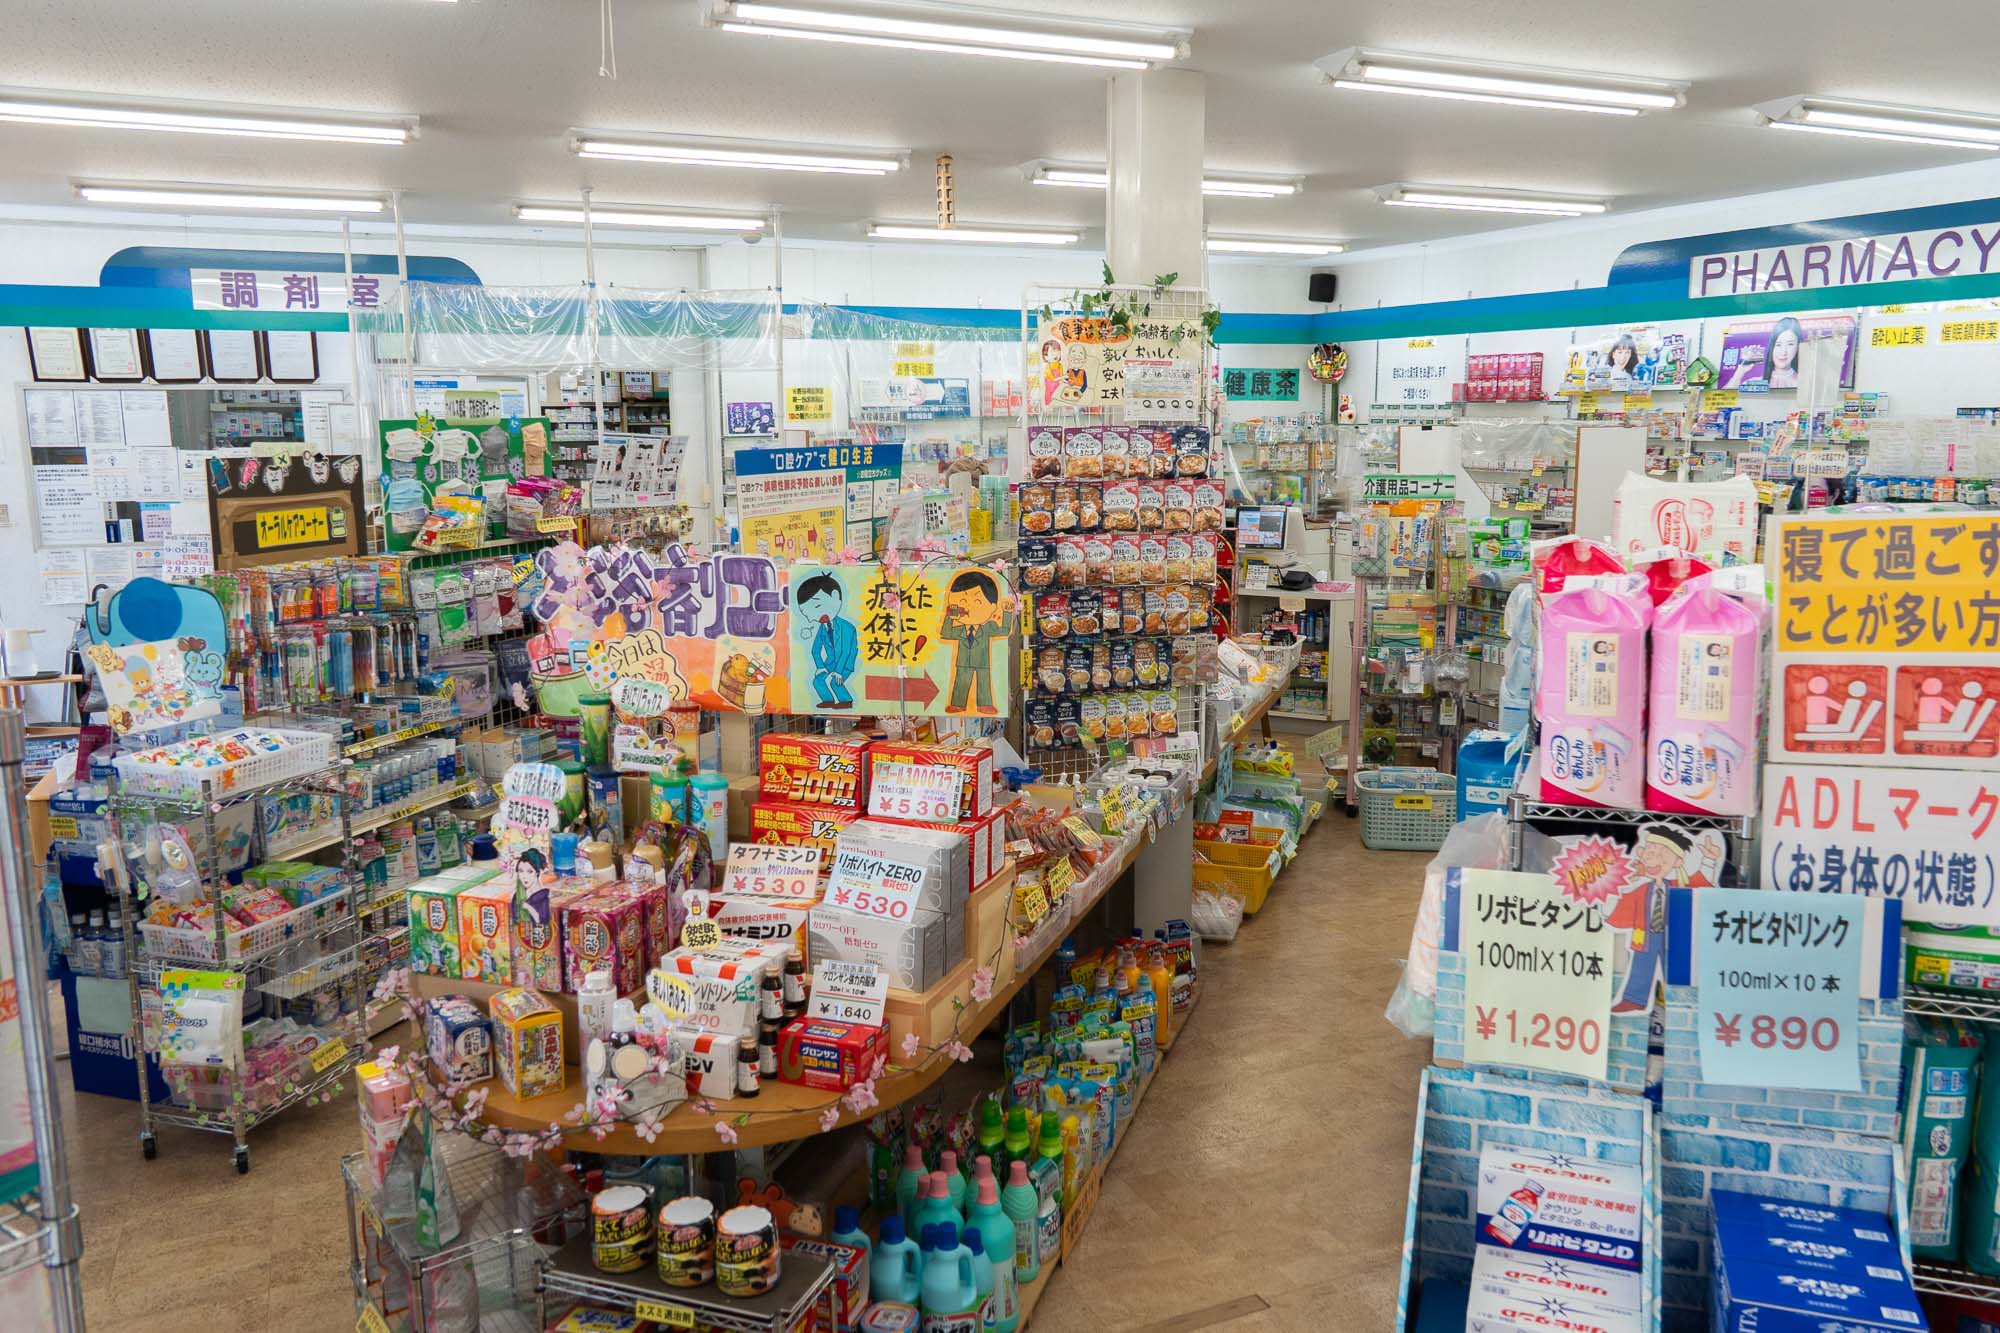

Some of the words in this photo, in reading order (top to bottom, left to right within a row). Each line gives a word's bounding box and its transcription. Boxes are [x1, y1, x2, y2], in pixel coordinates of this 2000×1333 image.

[1702, 229, 2000, 297] PHARMACY
[220, 271, 380, 310] 調剤室
[1225, 370, 1297, 397] 健康茶
[1364, 478, 1456, 497] 介護用品コーナー
[1782, 524, 2000, 583] 寝て過ごす
[536, 543, 789, 639] 入浴剤コー
[863, 581, 933, 611] 疲れた
[862, 613, 918, 635] 体に
[1785, 591, 2000, 648] ことが多い方
[817, 753, 856, 774] Vゴール
[789, 769, 857, 804] 3000
[832, 797, 856, 808] プラス
[879, 796, 950, 818] ¥530
[1773, 775, 1999, 840] ADLマーク
[733, 846, 818, 864] タフナミンD
[733, 875, 806, 896] ¥530
[1771, 841, 1995, 909] (お身体の状態)
[834, 885, 909, 919] ¥530
[1476, 893, 1603, 934] リポビタンD
[1712, 909, 1851, 950] チオビタドリンク
[1476, 940, 1604, 979] 100ml×10本
[1475, 1005, 1601, 1056] ¥1,290
[1714, 1011, 1841, 1053] ¥890
[801, 1046, 839, 1060] グロンサン
[1543, 1202, 1584, 1216] タウリン
[1527, 1229, 1635, 1261] リポビタンD
